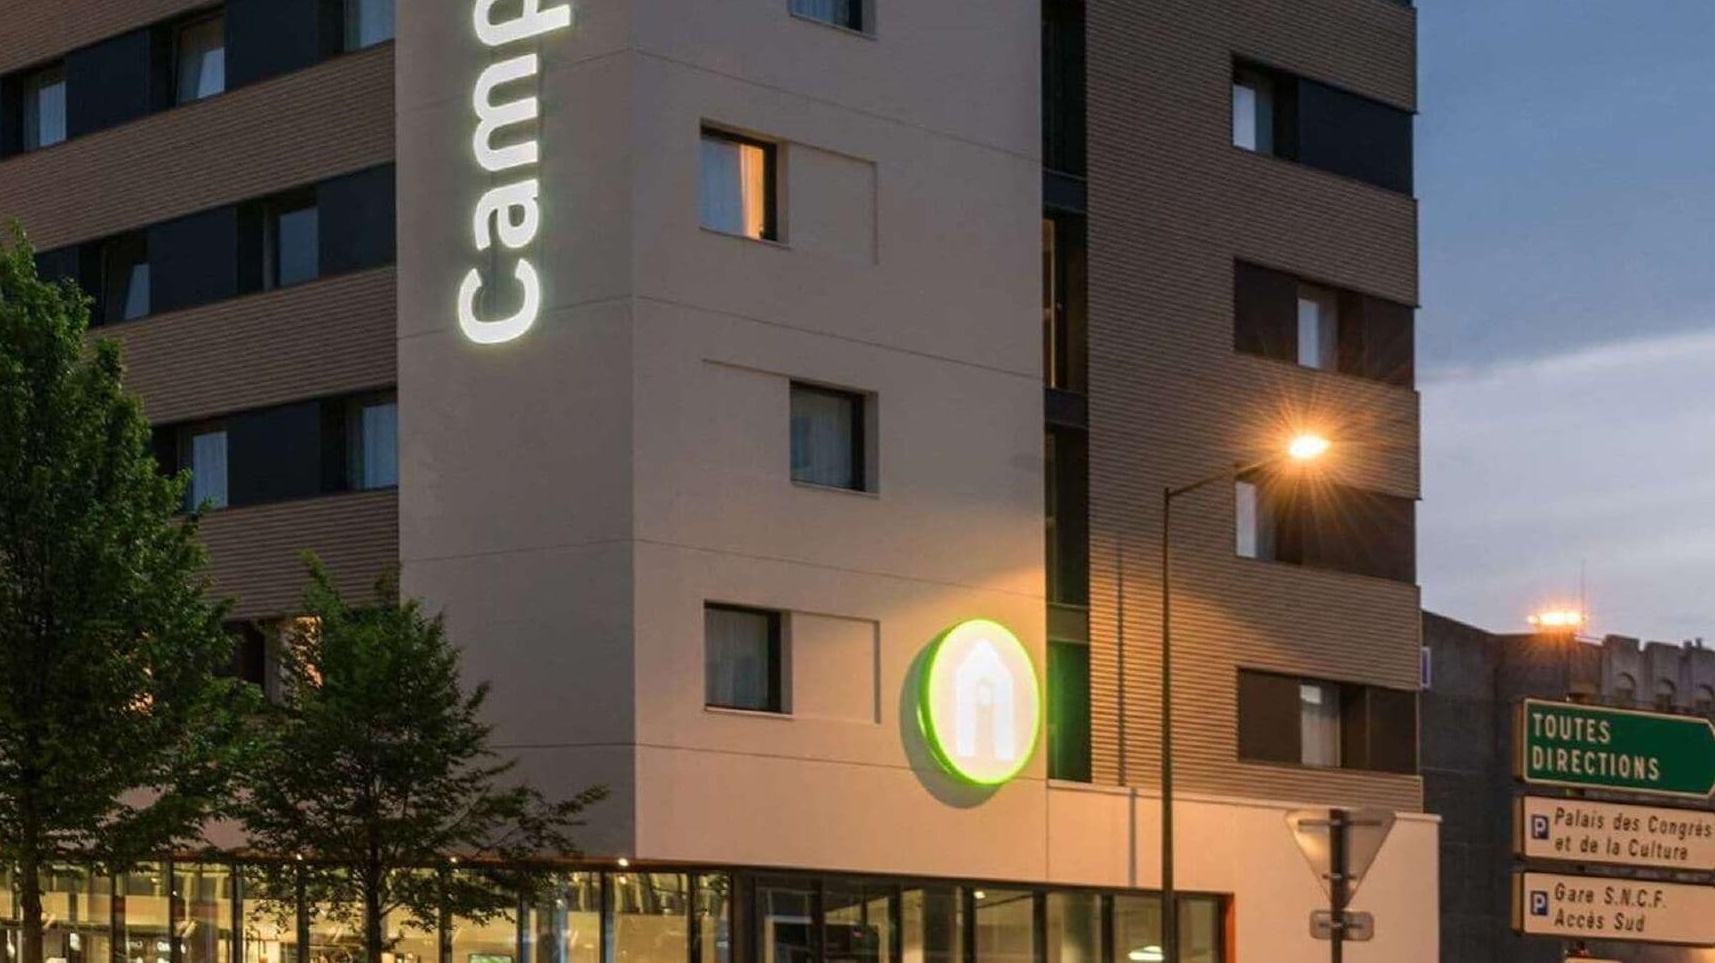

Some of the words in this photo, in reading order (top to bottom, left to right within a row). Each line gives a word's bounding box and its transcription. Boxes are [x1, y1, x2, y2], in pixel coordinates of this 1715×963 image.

[1532, 713, 1611, 743] TOUTES
[1532, 744, 1661, 781] DIRECTIONS
[1554, 807, 1605, 829] Palais
[1613, 813, 1640, 832] des
[1555, 837, 1571, 852] et
[1580, 835, 1599, 853] de
[1606, 837, 1620, 856] la
[1628, 839, 1688, 860] Culture
[1554, 882, 1595, 904] Gare
[1604, 886, 1668, 908] S.N.C.F.
[1614, 912, 1646, 933] Sud
